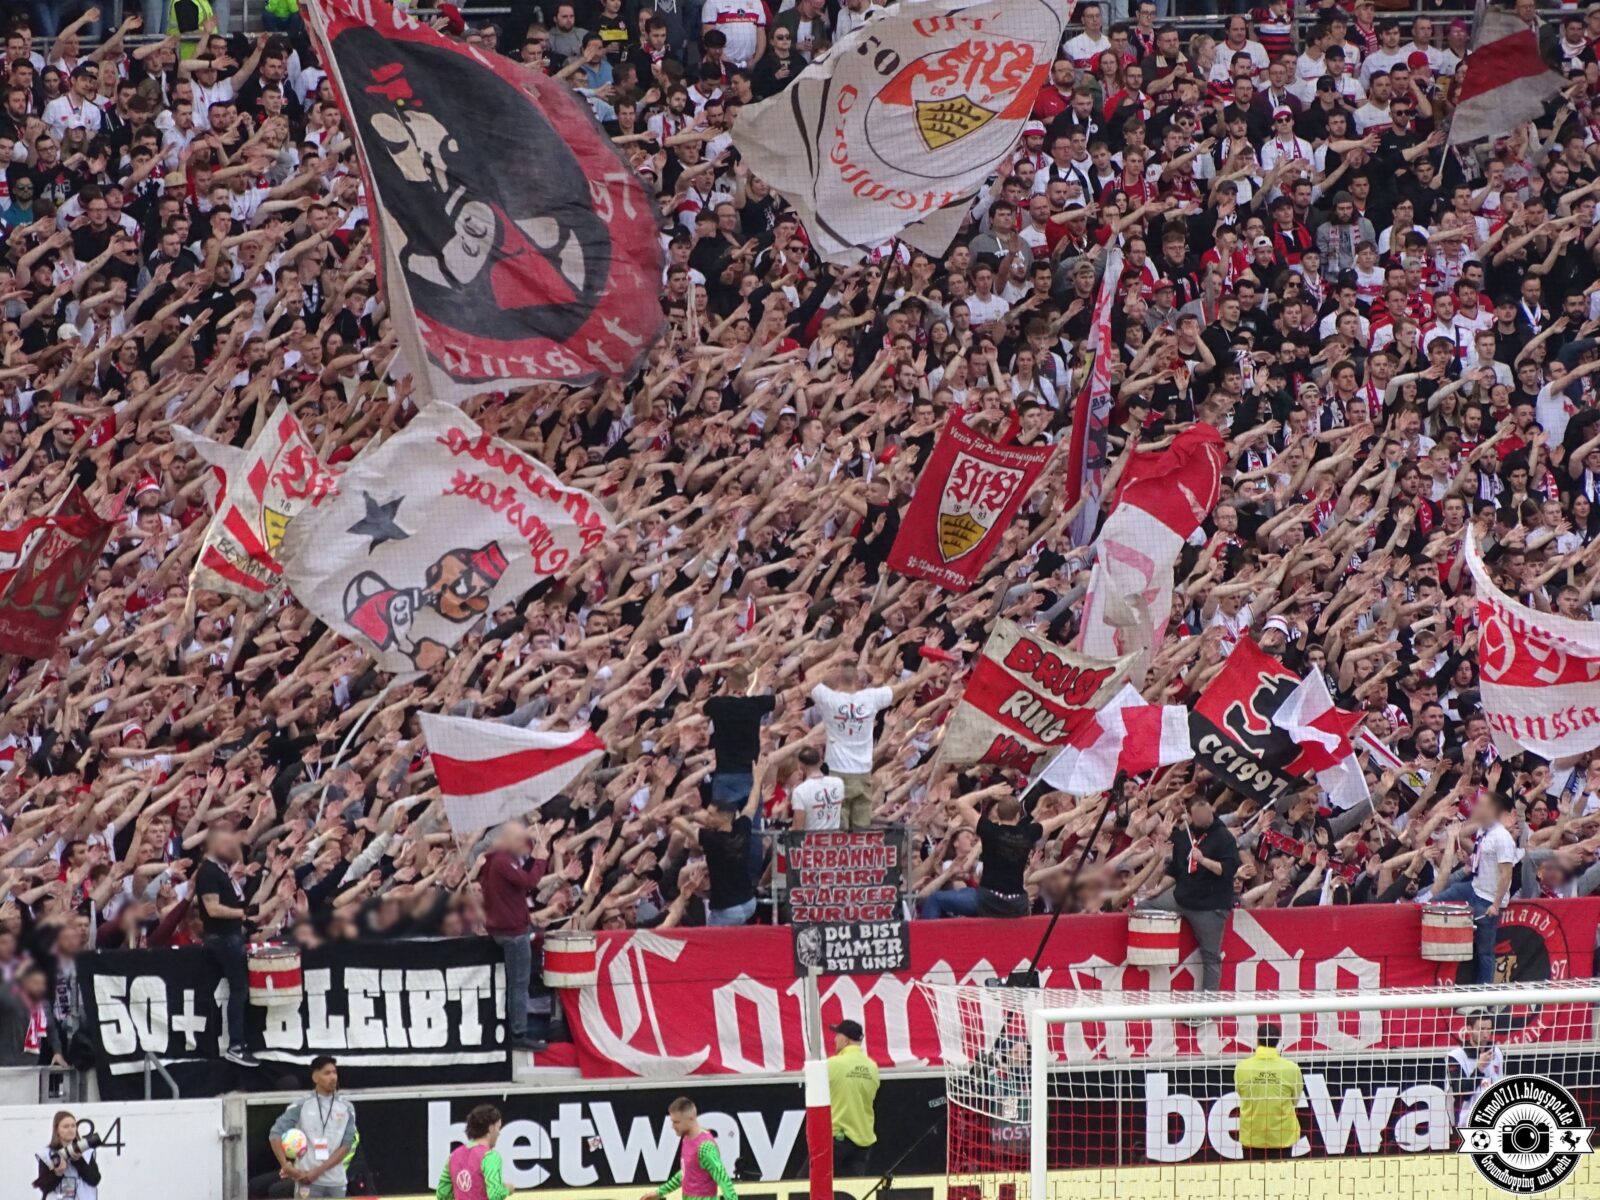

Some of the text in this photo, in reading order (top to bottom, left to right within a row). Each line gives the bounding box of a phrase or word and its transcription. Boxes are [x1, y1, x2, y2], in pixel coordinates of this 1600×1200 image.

[589, 172, 636, 222] 97
[1003, 637, 1116, 706] BRUST
[999, 690, 1070, 742] RING
[1199, 734, 1288, 798] CC1997
[801, 831, 885, 848] JEDER
[789, 846, 896, 869] VERBANNTE
[800, 869, 888, 886] KEHRT
[825, 923, 901, 941] DU BIST
[826, 939, 903, 957] IMMER
[827, 955, 904, 971] BEI UNS!
[1551, 959, 1568, 980] 97
